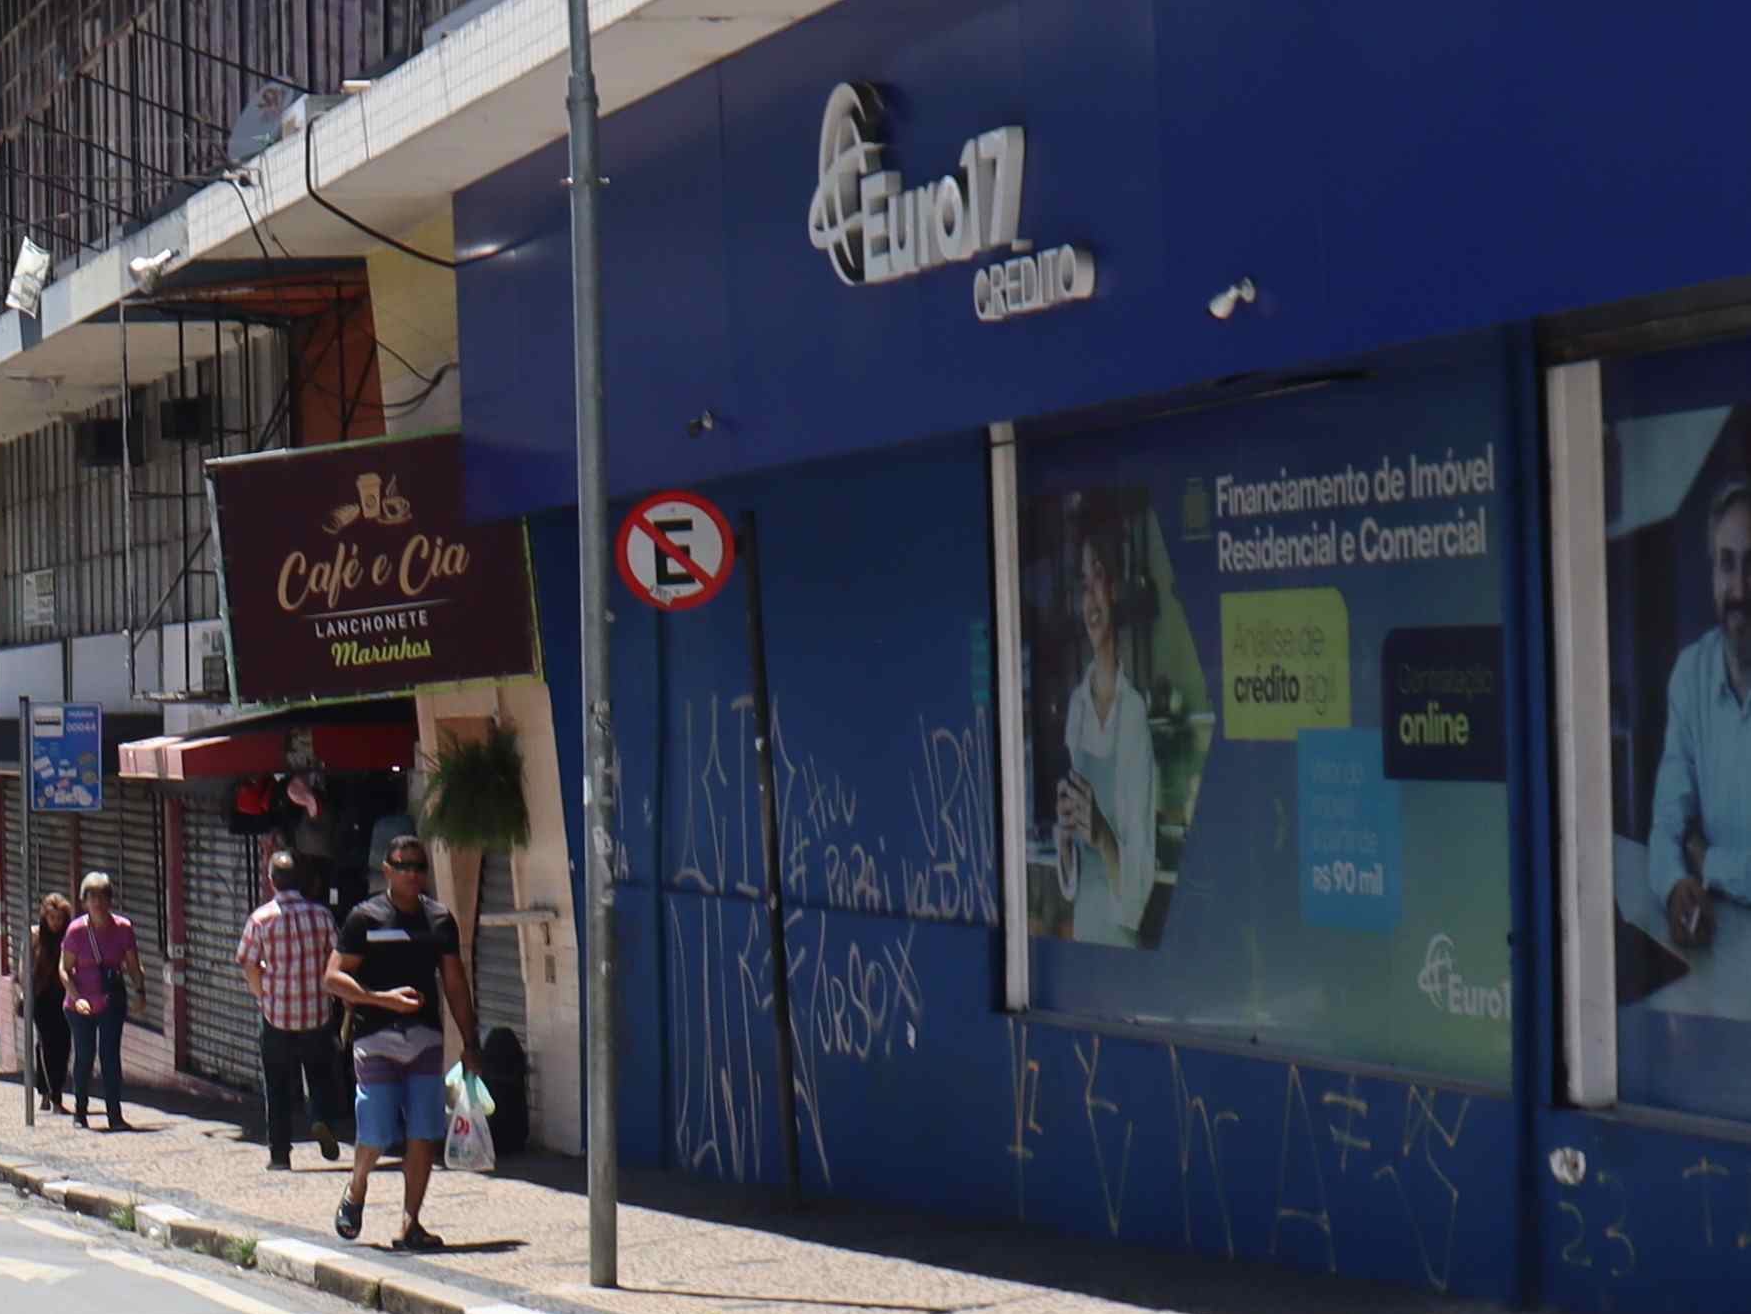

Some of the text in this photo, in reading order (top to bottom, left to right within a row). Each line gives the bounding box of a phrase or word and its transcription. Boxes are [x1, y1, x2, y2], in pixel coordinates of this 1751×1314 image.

[860, 125, 1026, 284] Euro17
[1215, 442, 1495, 517] Financiamento de Imóvel
[1218, 507, 1487, 572] Residencial e Comercial
[276, 535, 470, 611] Café e Cia
[314, 609, 429, 638] LANCHONETE
[330, 636, 432, 667] Marinhos
[1233, 664, 1301, 704] crédito
[1399, 703, 1469, 745] online
[1333, 860, 1355, 895] 90
[1358, 863, 1384, 896] mil
